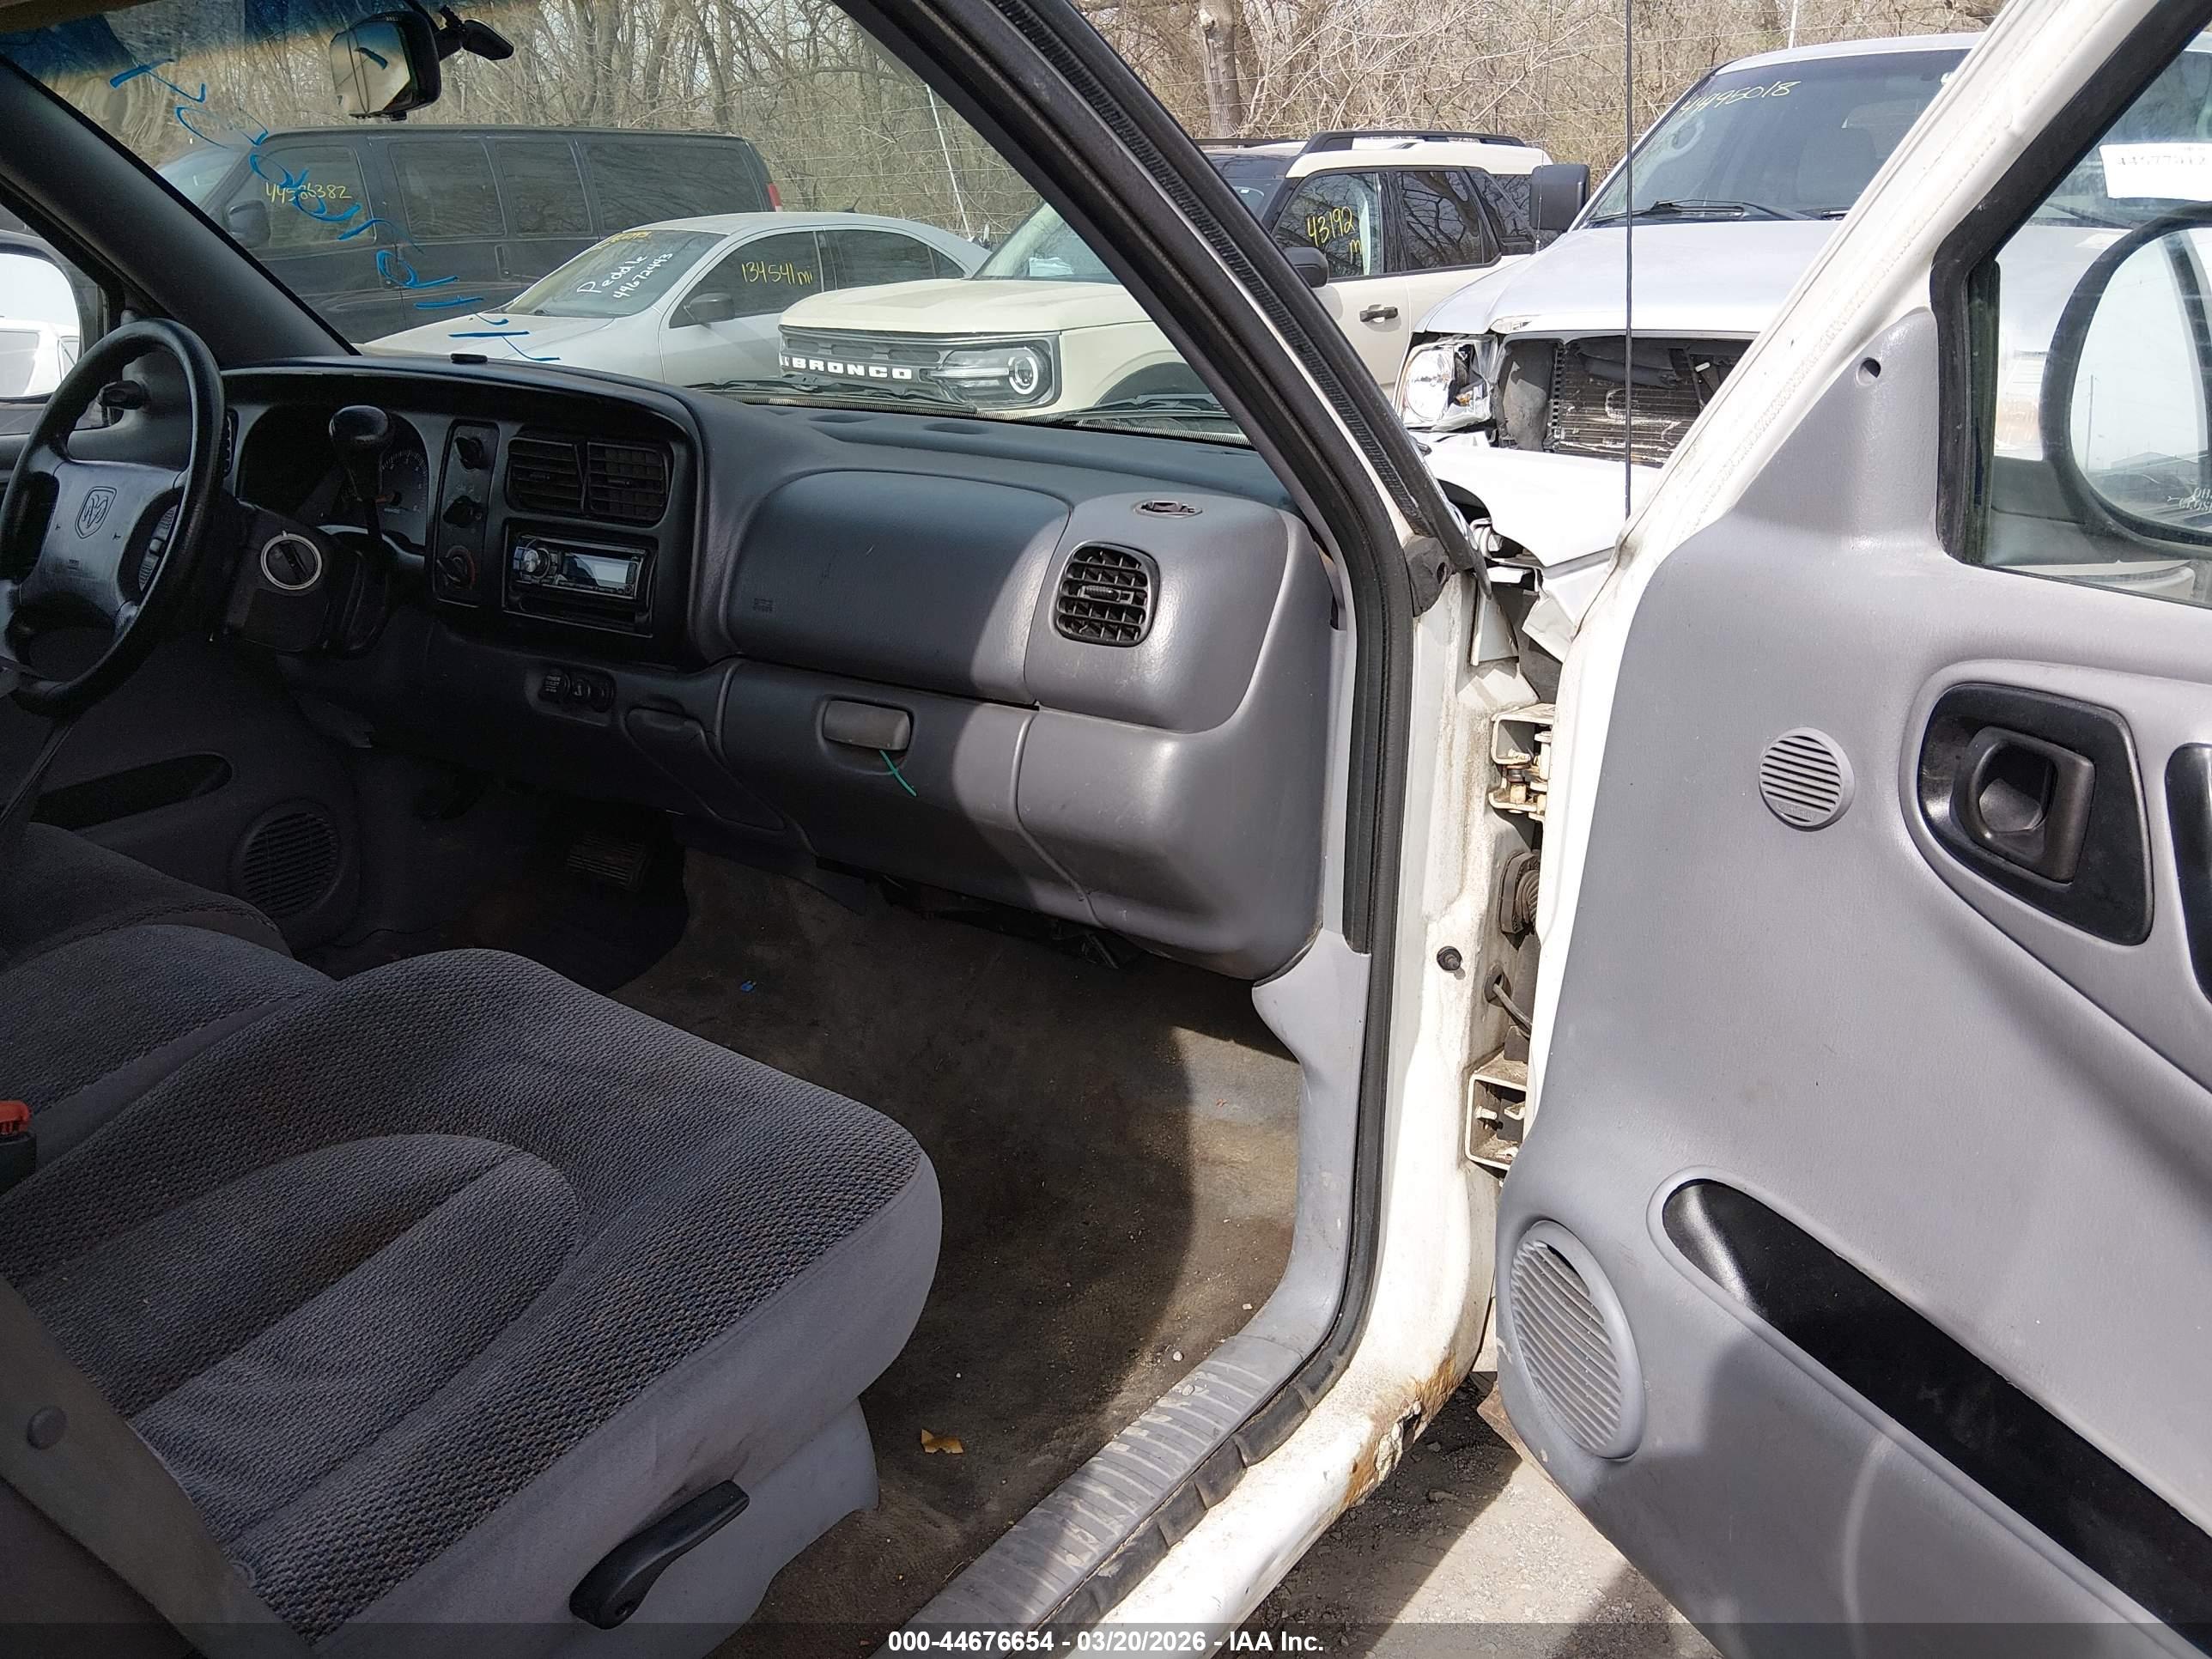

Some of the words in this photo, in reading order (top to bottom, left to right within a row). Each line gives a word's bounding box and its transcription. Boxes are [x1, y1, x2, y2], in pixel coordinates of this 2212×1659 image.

[1307, 205, 1356, 249] 43192
[576, 255, 648, 294] Peddle
[792, 356, 913, 380] BRONCO
